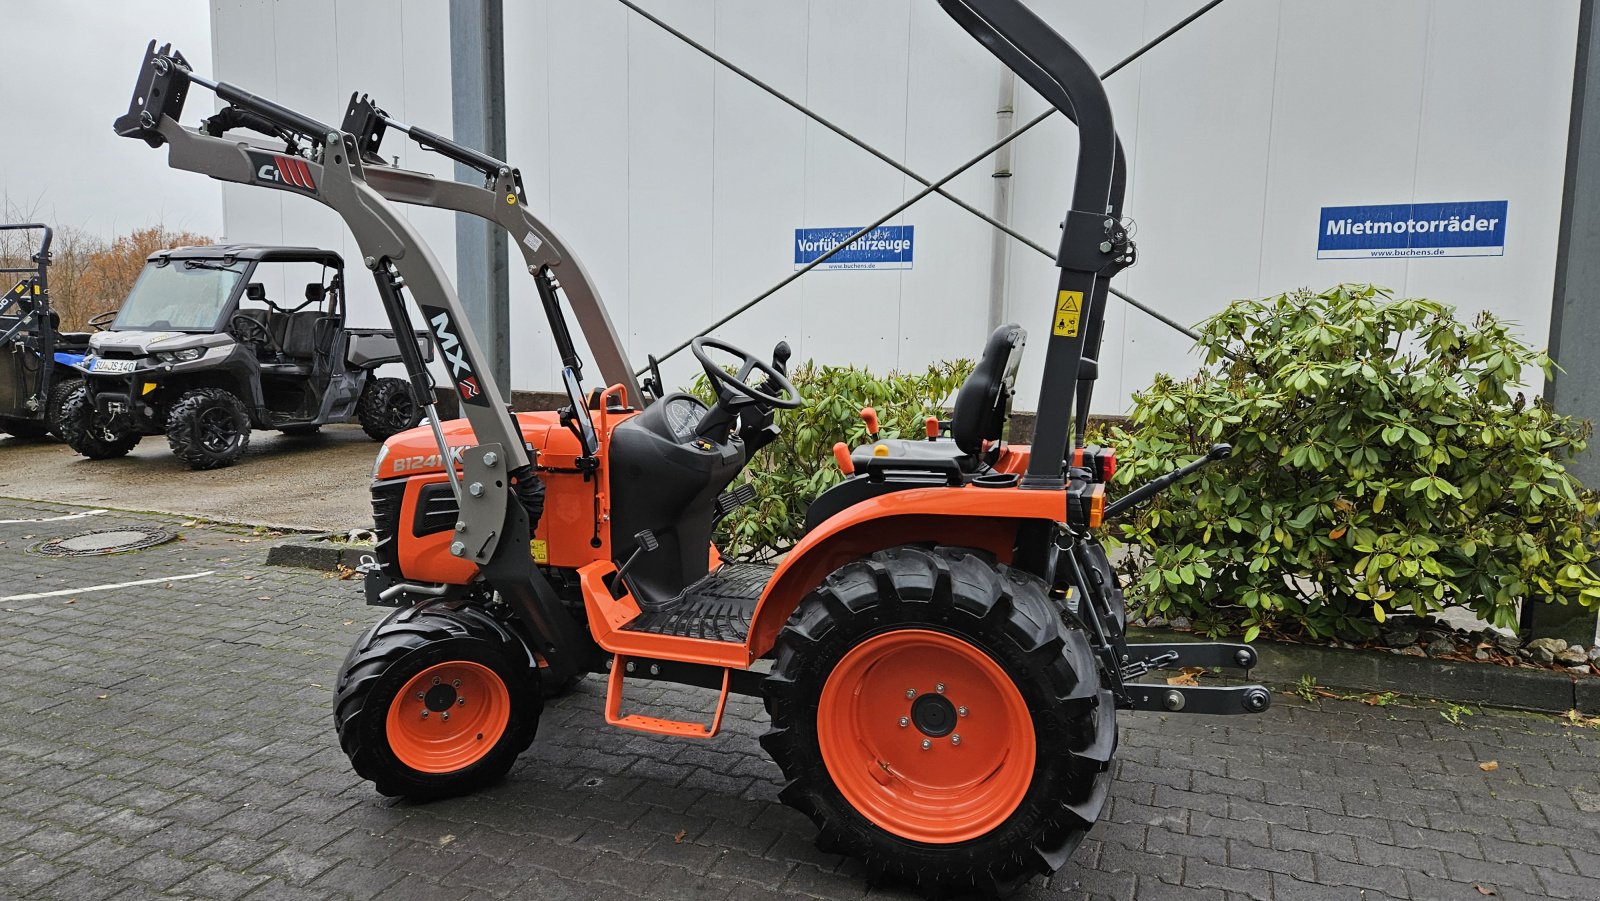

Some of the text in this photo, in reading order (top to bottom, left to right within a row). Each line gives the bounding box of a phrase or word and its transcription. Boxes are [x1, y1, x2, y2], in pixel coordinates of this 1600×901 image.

[258, 164, 279, 181] C1
[1326, 214, 1499, 236] Mietmotorräder
[798, 236, 910, 253] Vorfühahrzeuge
[1370, 248, 1445, 257] www.buchens.de
[430, 312, 472, 378] MX
[393, 454, 443, 472] B1241
